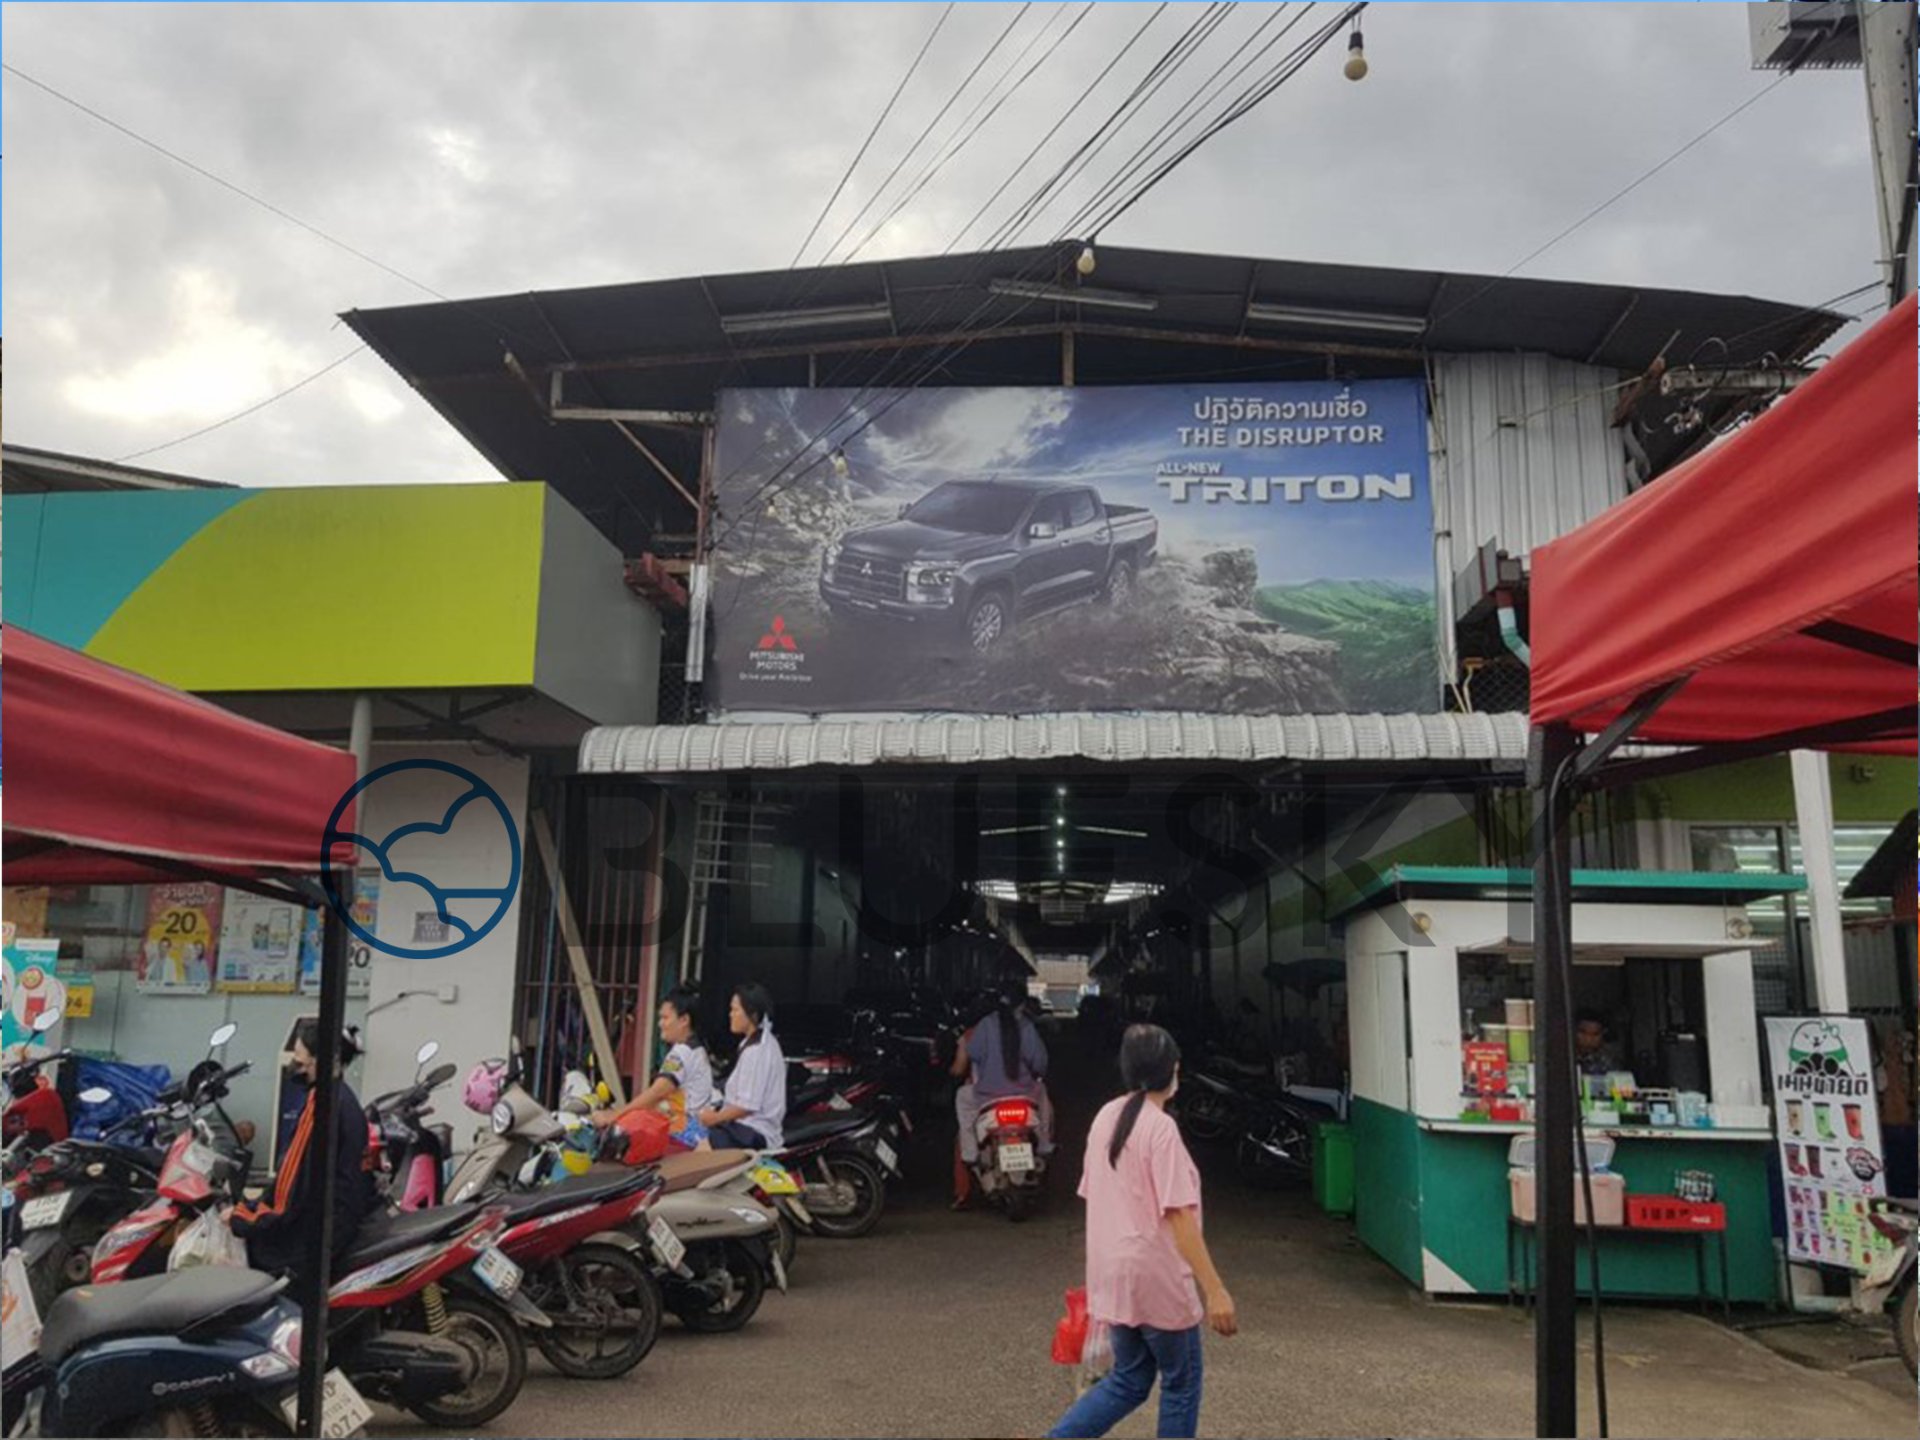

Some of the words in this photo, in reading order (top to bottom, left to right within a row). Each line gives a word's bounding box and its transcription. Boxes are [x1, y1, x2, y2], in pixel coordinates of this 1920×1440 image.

[1194, 387, 1367, 425] ปฏิวัติความเชื่อ
[1178, 427, 1227, 446] THE
[1237, 425, 1384, 446] DISRUPTOR
[1156, 461, 1222, 475] ALL-NEW
[1156, 474, 1412, 502] TRITON
[165, 911, 197, 935] 20
